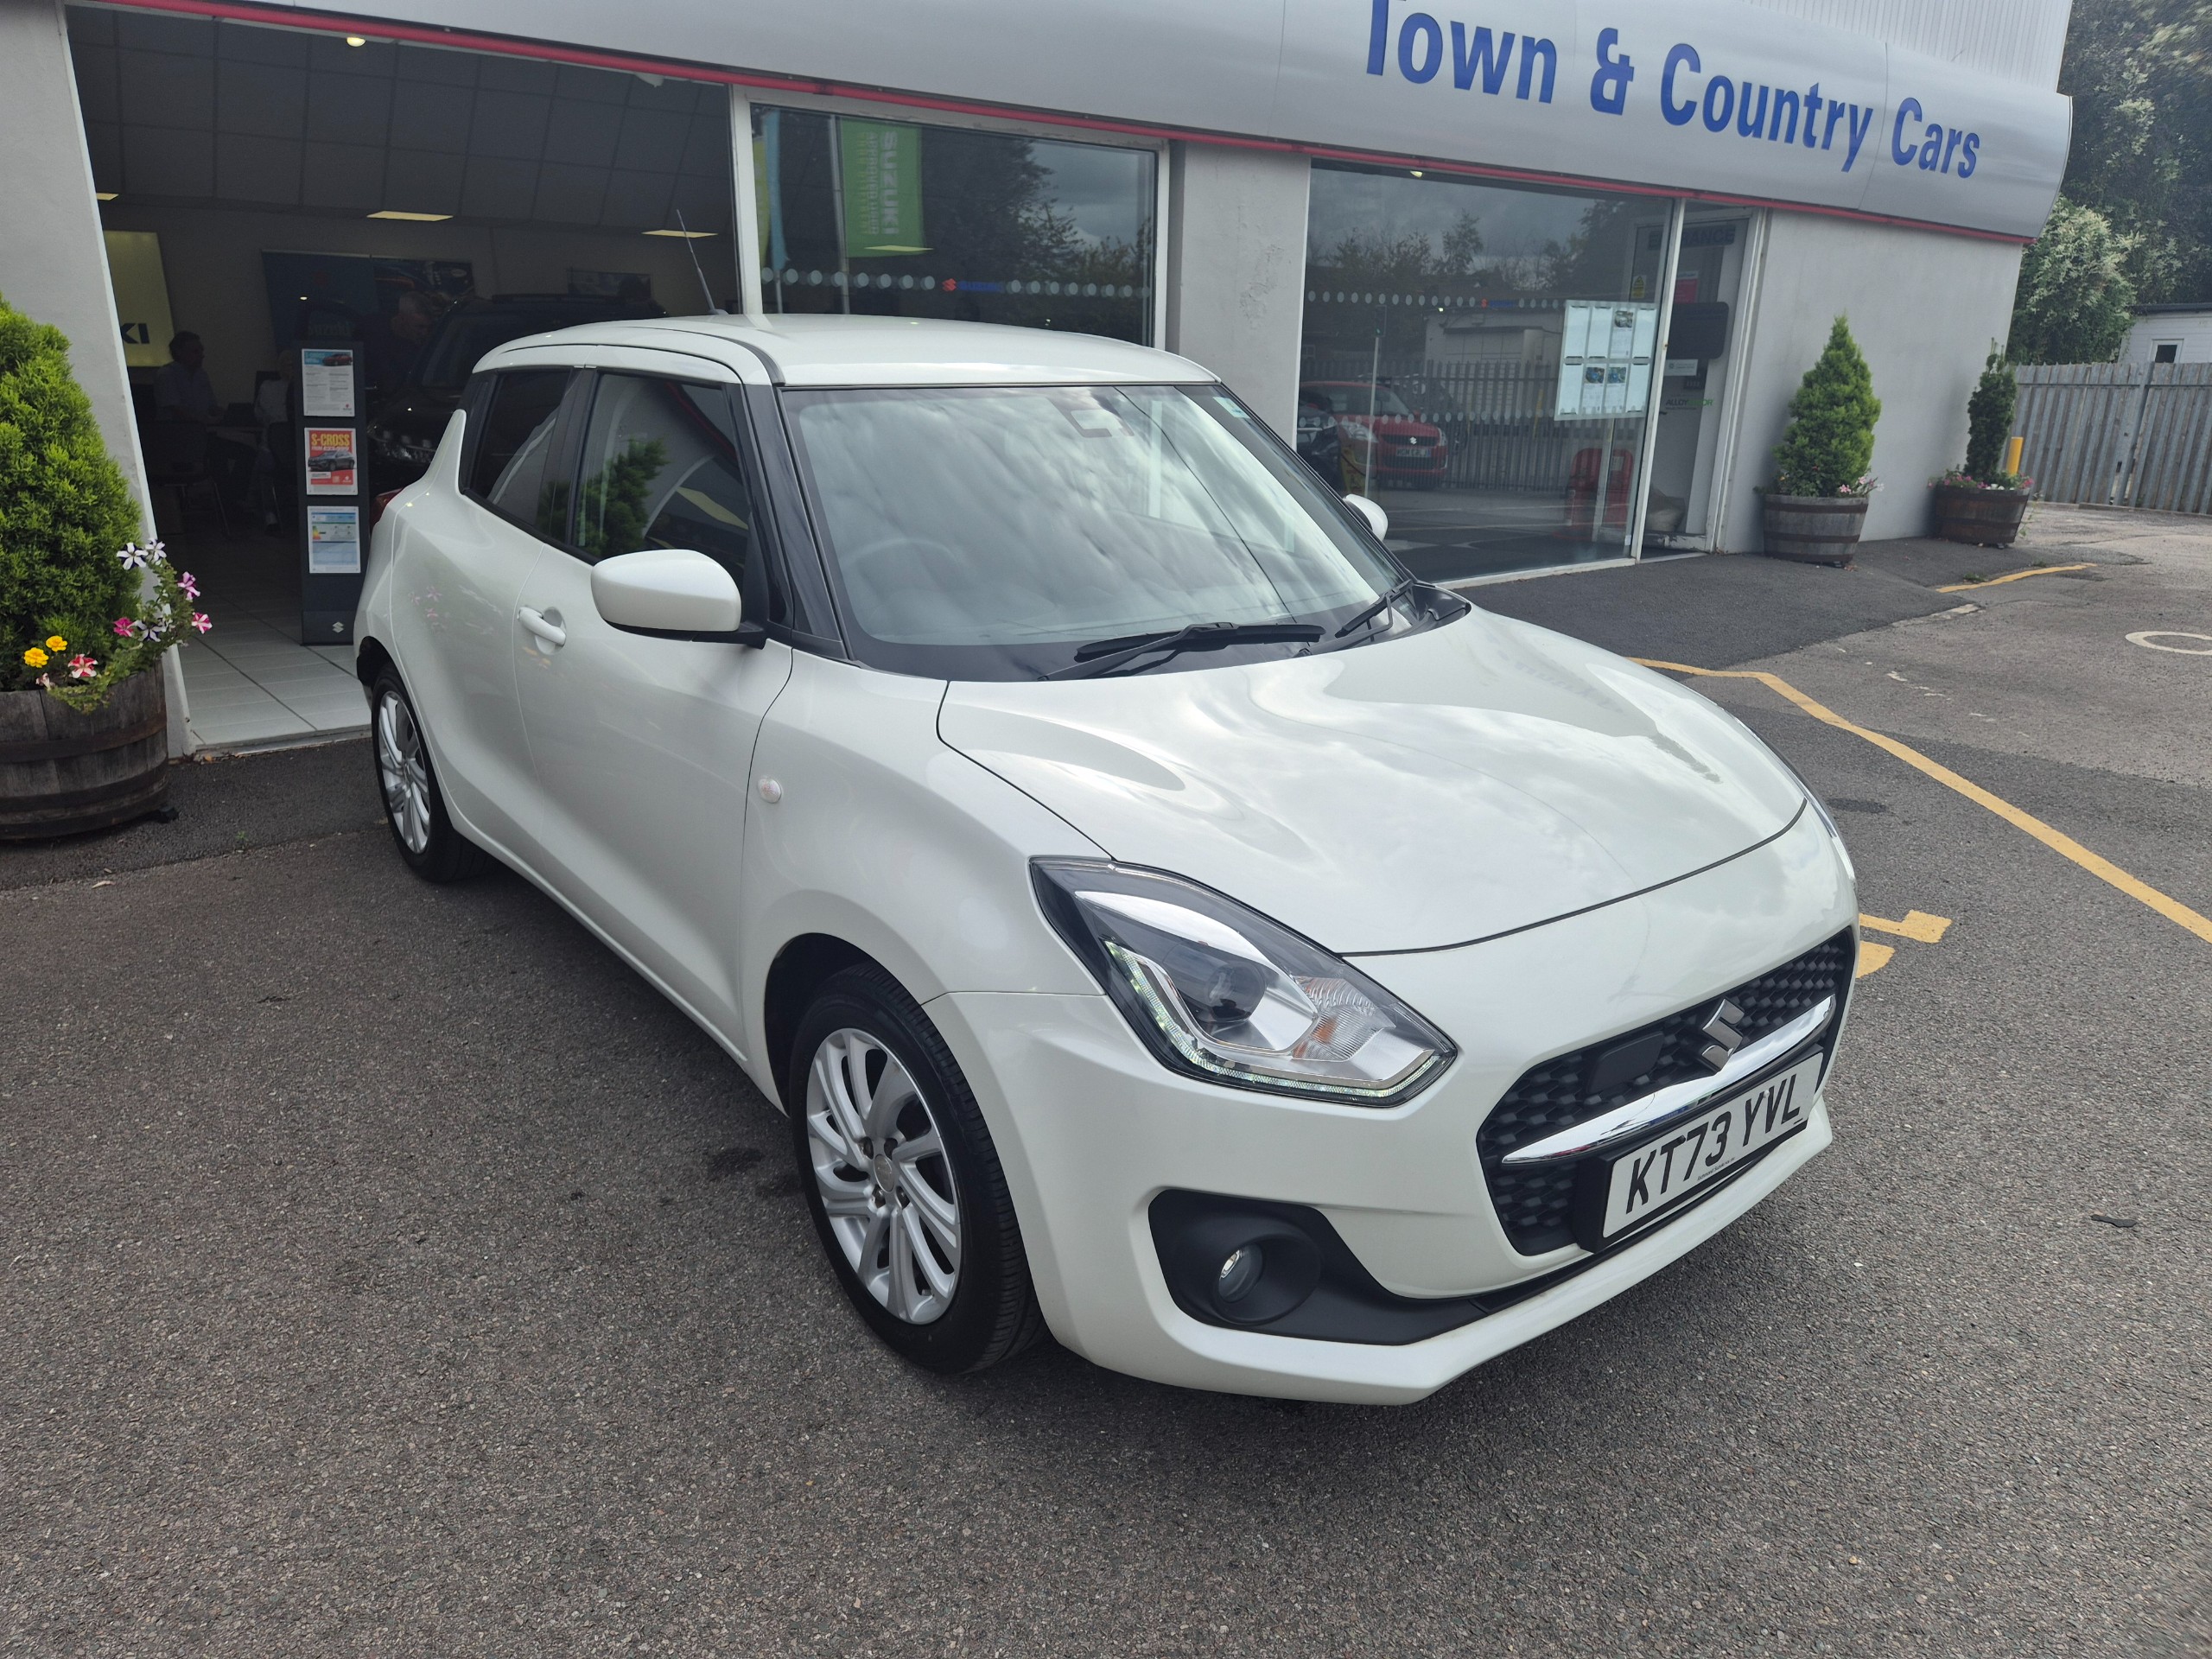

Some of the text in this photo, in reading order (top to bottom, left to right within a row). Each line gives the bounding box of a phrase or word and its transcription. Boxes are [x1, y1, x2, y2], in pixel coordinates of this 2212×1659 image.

[1366, 0, 1980, 179] Town & Country Cars
[881, 130, 899, 235] SUZUKI
[311, 433, 350, 446] S-CROSS
[1626, 1073, 1800, 1214] KT73 YVL
